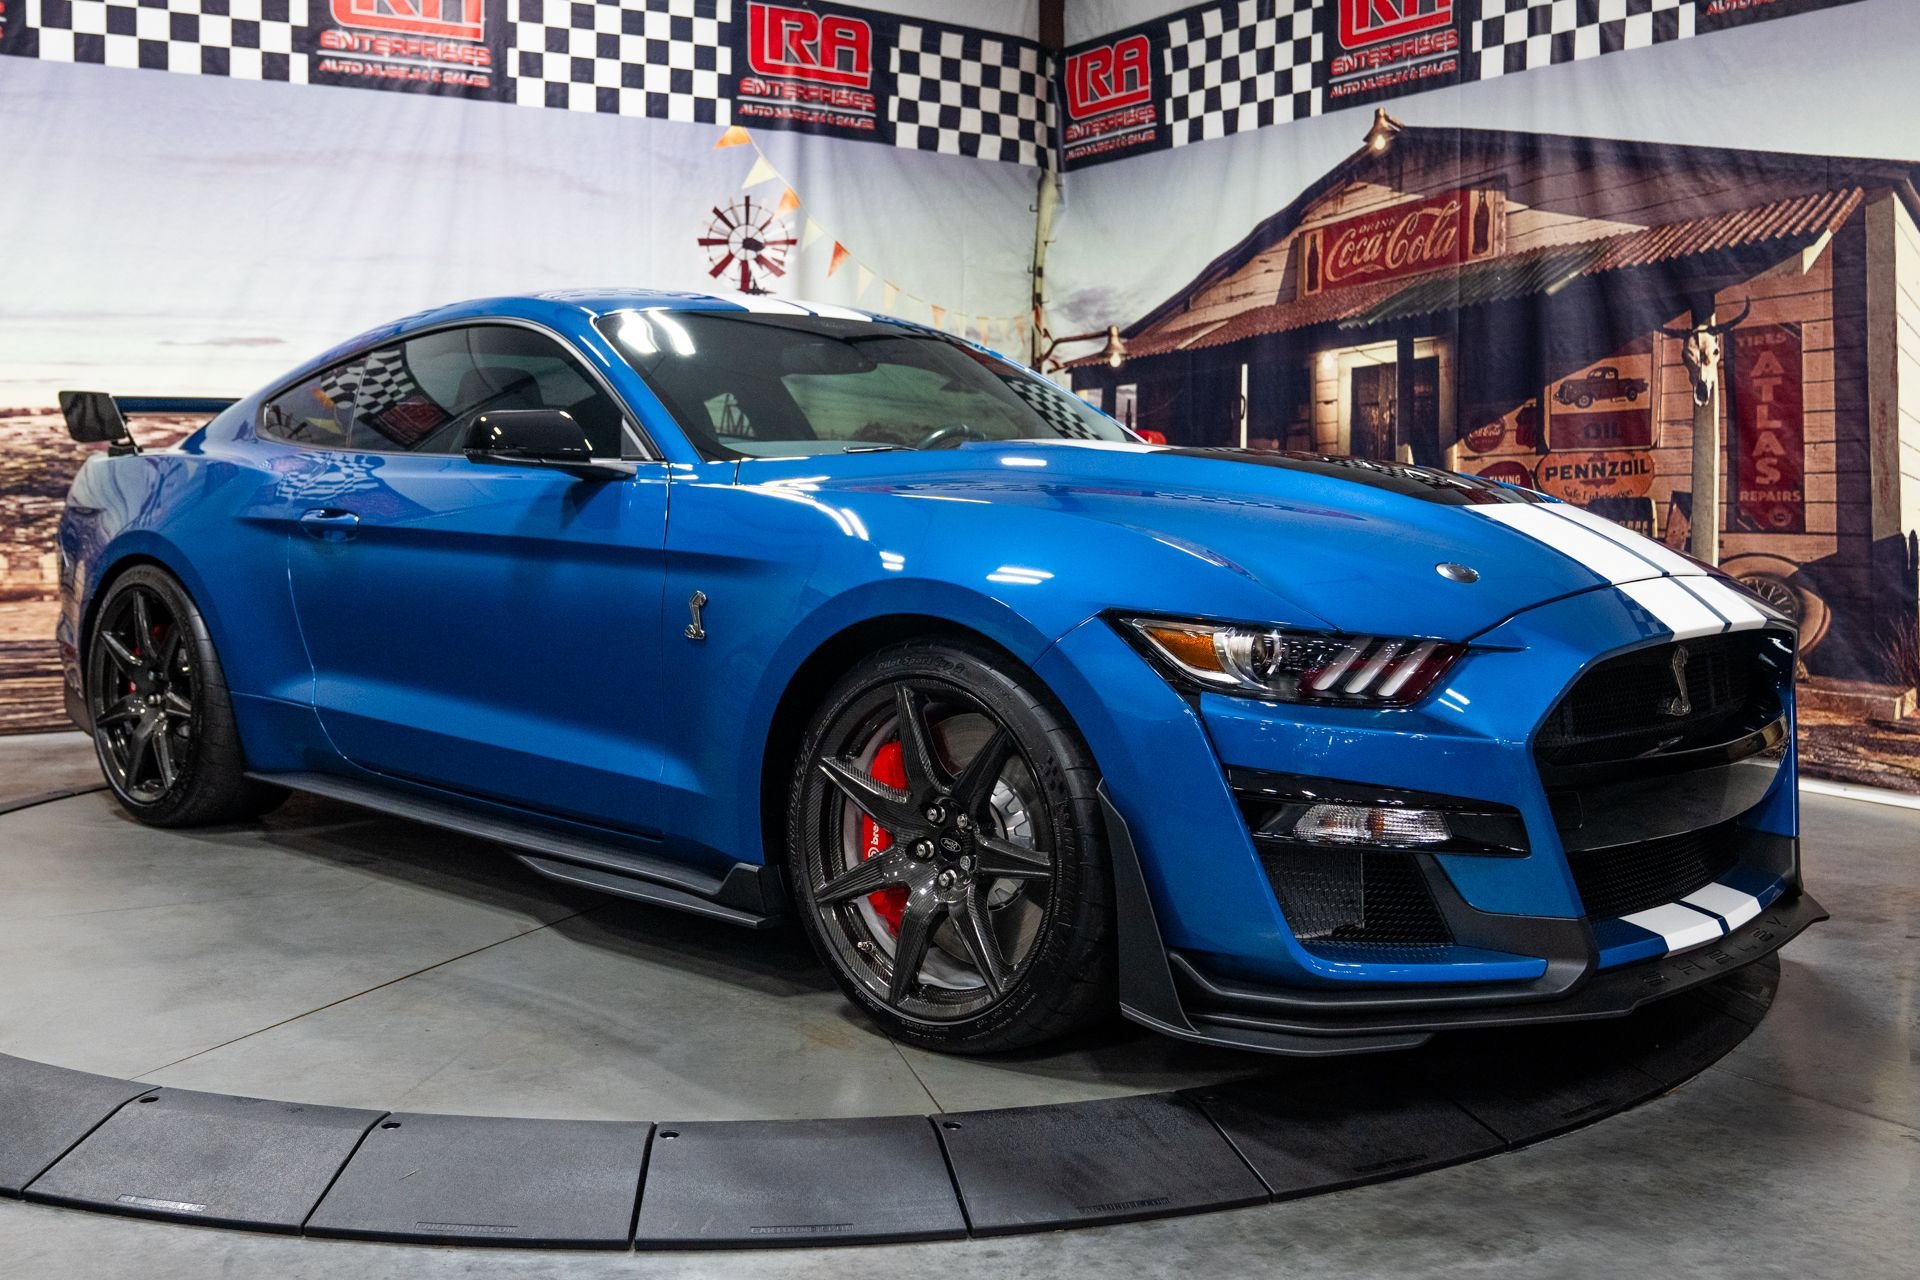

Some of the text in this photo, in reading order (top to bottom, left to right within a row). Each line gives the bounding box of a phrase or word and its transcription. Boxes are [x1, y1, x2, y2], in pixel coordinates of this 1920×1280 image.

[319, 30, 491, 65] ENTERPRISES
[747, 1, 872, 89] LRA
[1331, 29, 1458, 75] ENTERPRISES
[319, 59, 363, 76] AUTO
[1064, 34, 1152, 120] LRA
[740, 77, 875, 111] ENTERPRISES
[1330, 82, 1360, 98] AUTO
[1736, 333, 1787, 348] TIRES
[1583, 422, 1624, 441] OIL
[1750, 351, 1786, 485] ATLAS
[1544, 459, 1650, 482] PENNZOIL
[1739, 490, 1802, 502] REPAIRS
